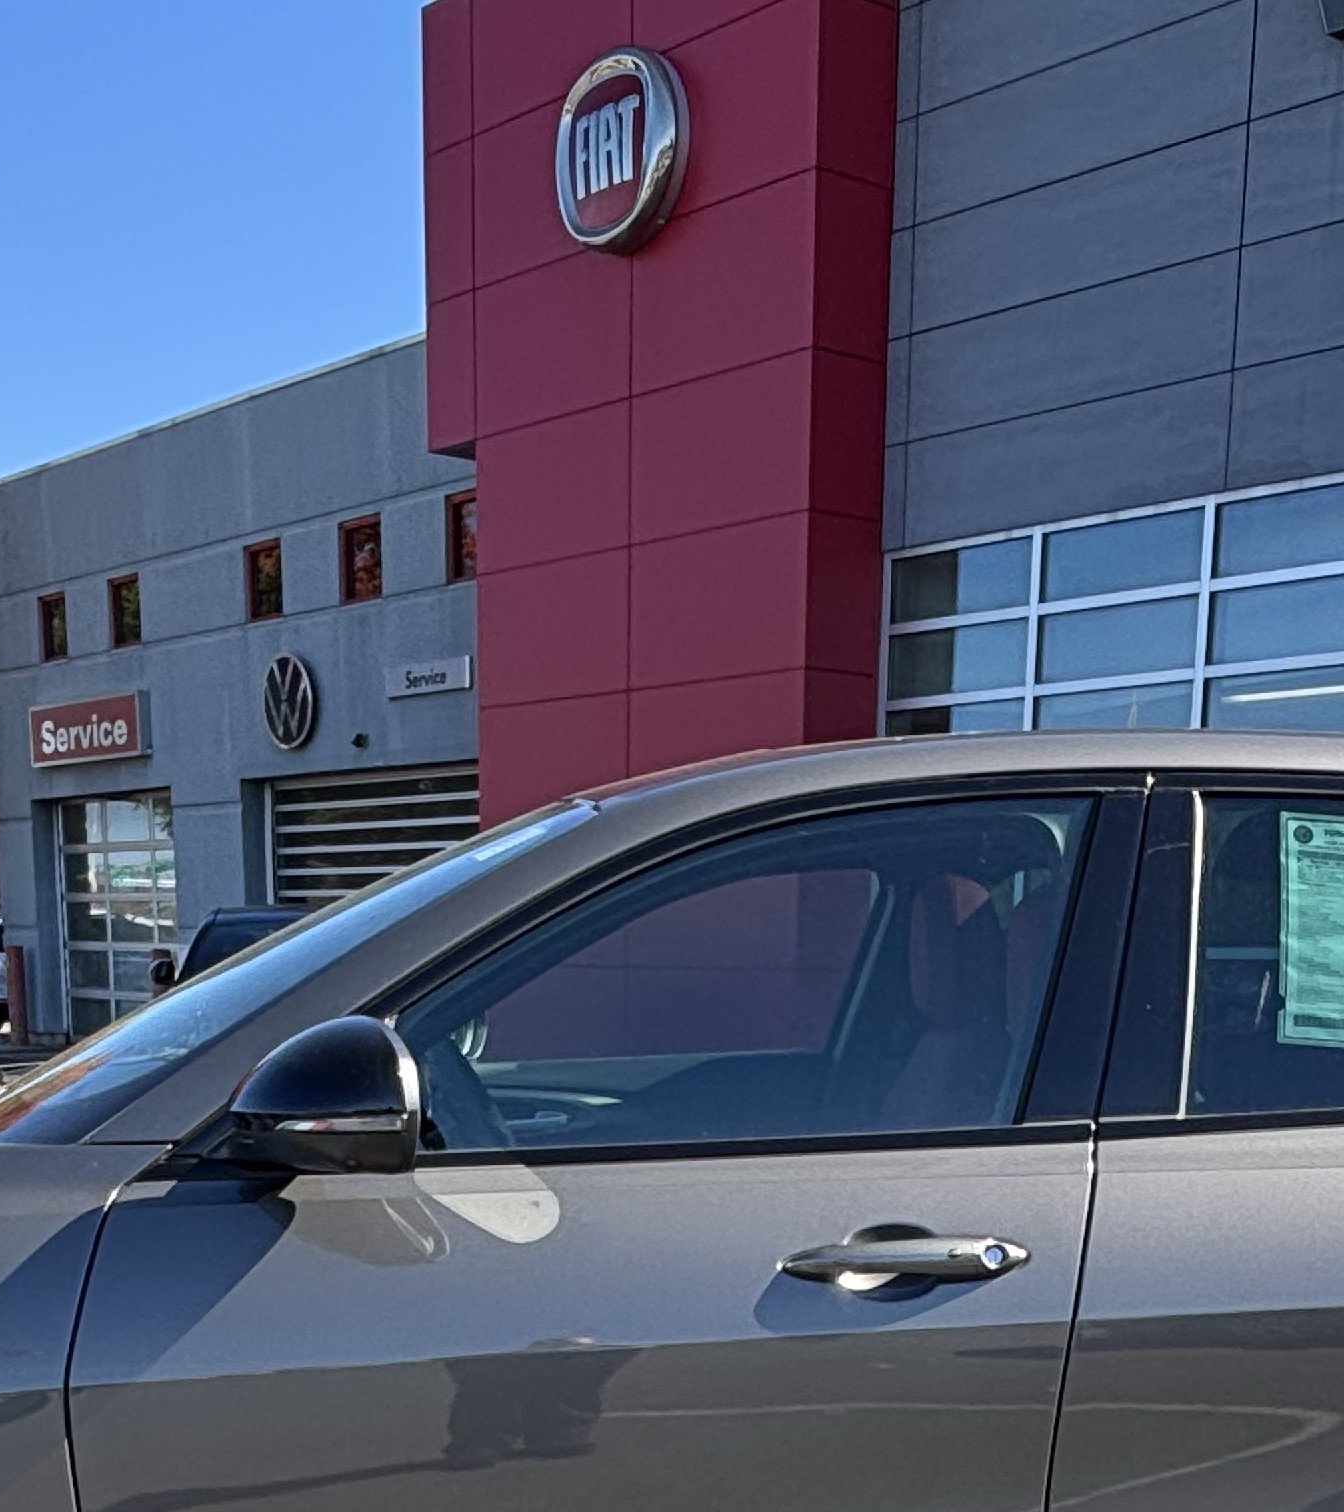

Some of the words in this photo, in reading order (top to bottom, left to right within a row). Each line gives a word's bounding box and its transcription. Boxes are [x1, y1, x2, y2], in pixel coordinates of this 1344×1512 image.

[575, 93, 641, 201] FIAT
[406, 668, 447, 690] Service
[41, 713, 128, 754] Service
